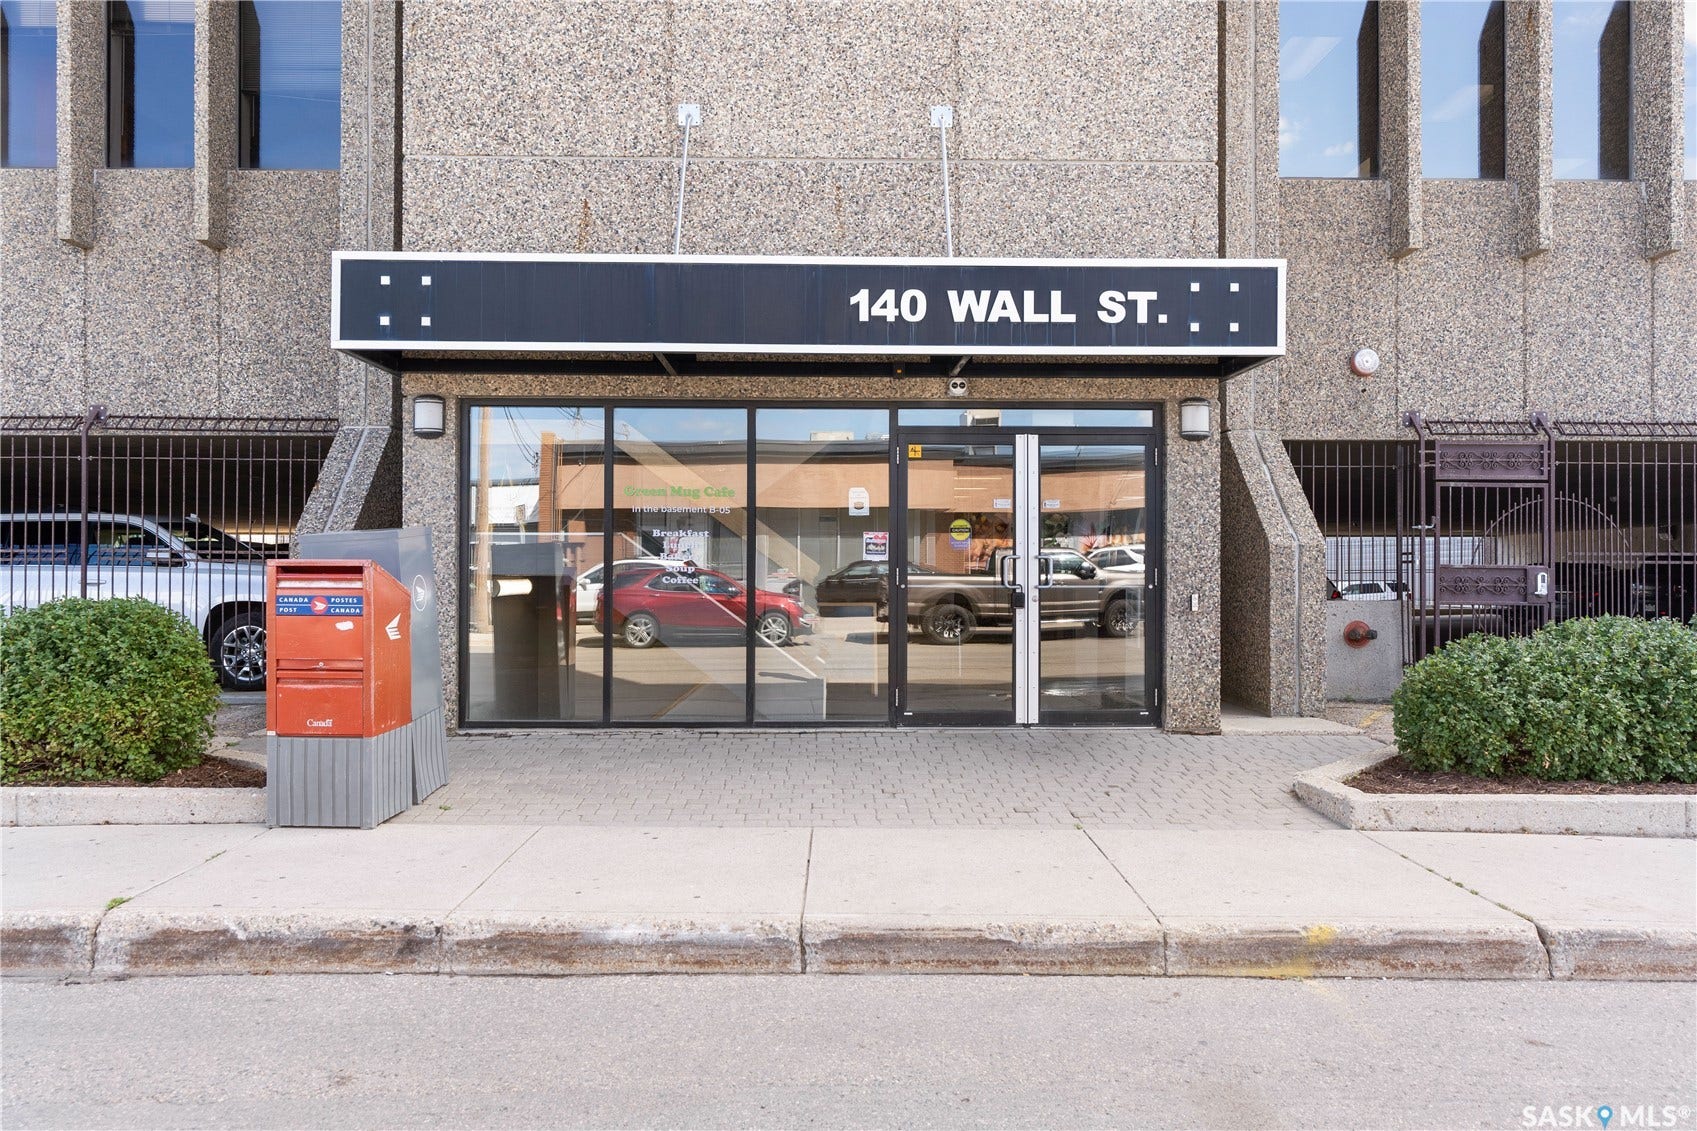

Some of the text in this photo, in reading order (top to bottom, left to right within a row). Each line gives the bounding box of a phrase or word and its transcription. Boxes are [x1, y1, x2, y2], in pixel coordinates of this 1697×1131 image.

[849, 288, 1168, 324] 140 WALL ST.
[624, 486, 735, 499] Green Mug Cafe
[643, 505, 659, 513] the
[661, 505, 706, 513] basement
[709, 506, 731, 514] B-05
[652, 529, 710, 537] Breakfast
[662, 576, 699, 584] Coffee
[306, 719, 333, 727] Canada
